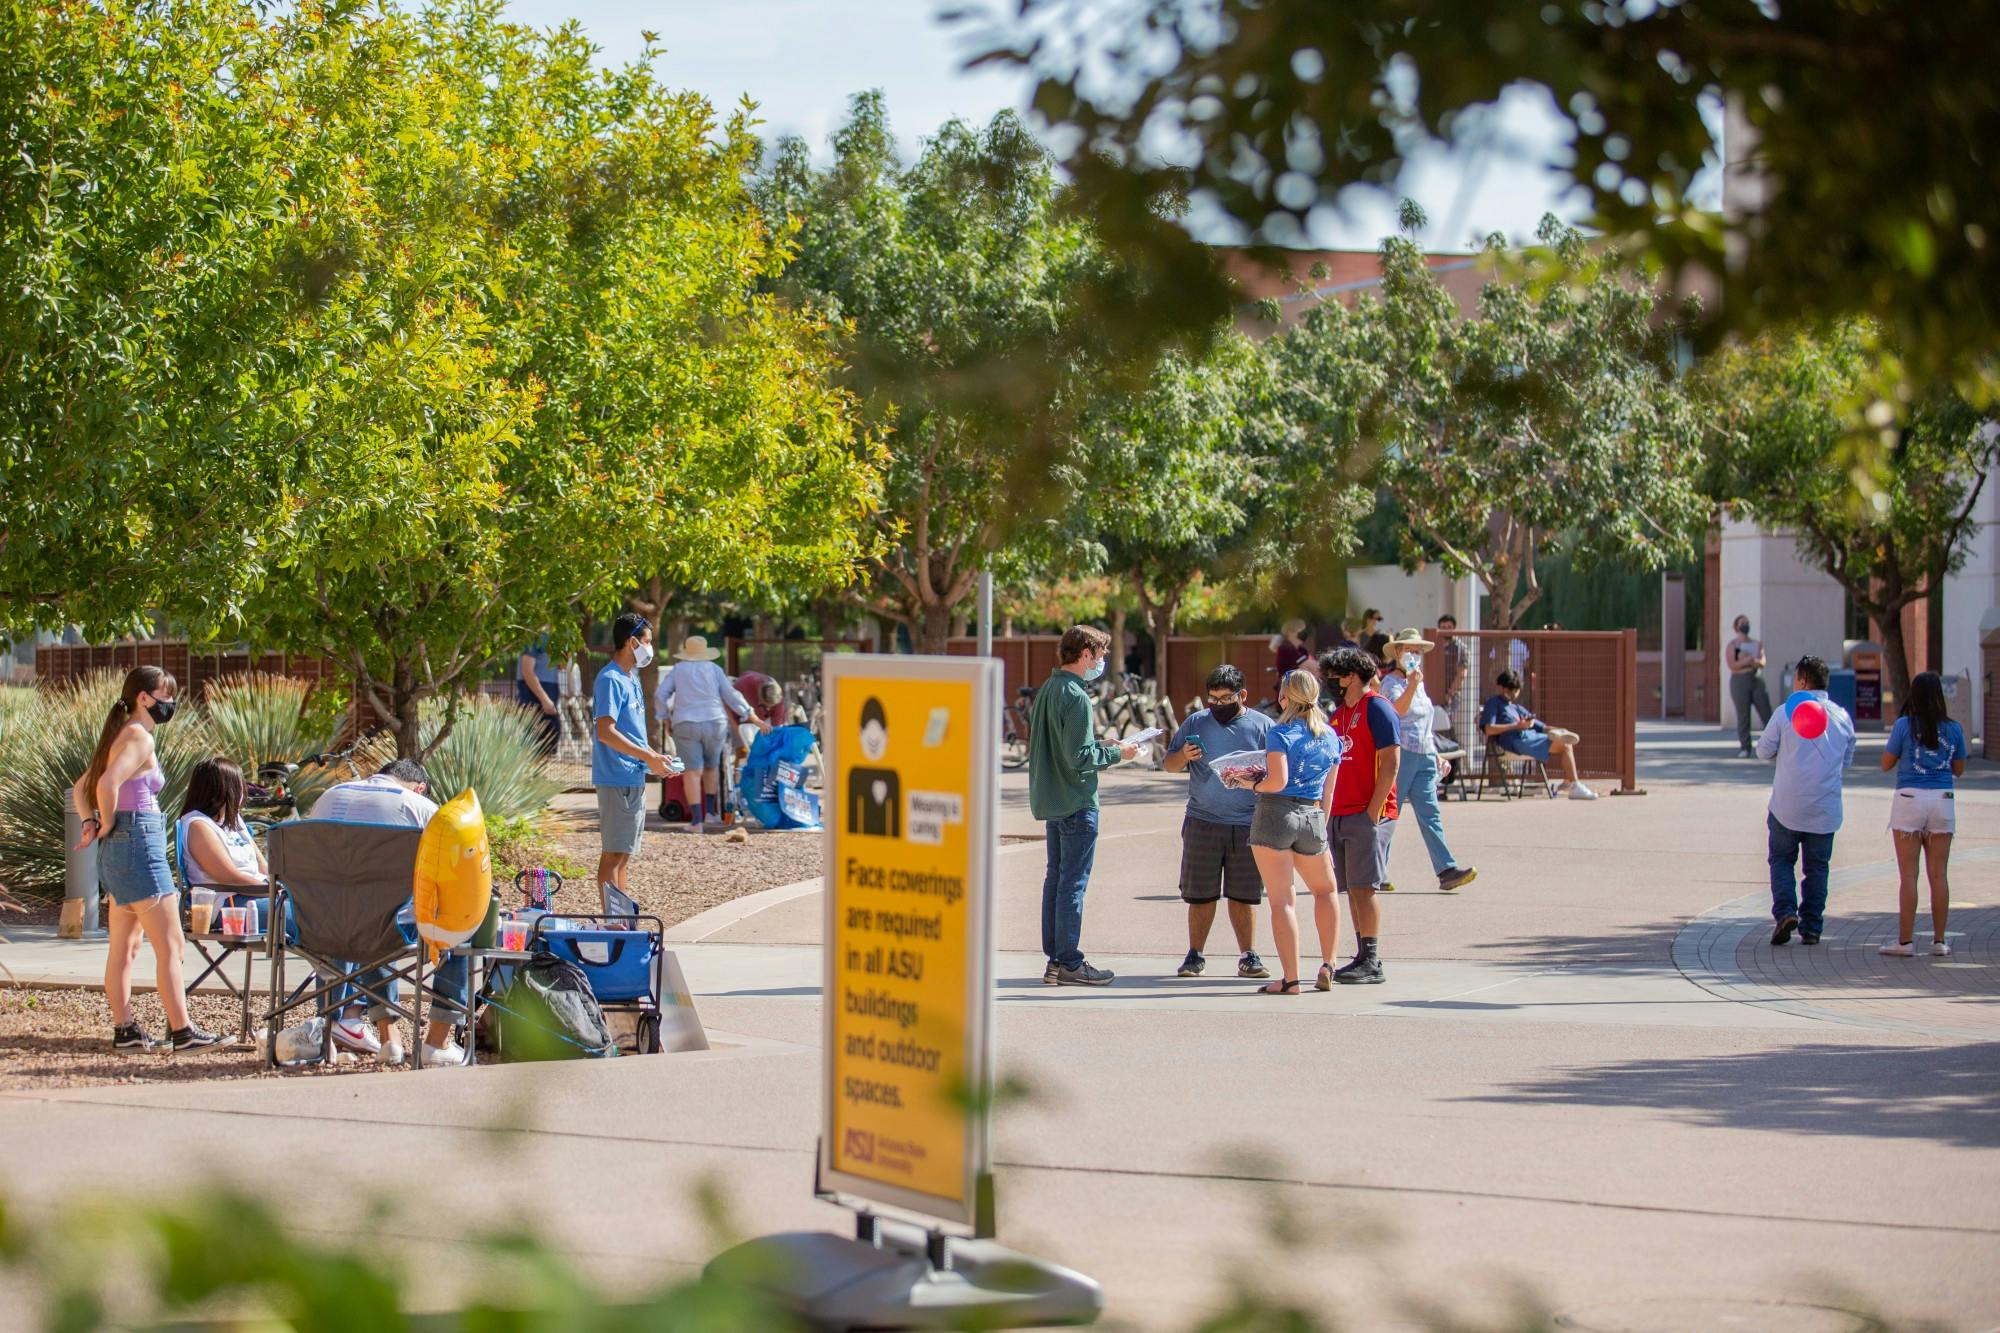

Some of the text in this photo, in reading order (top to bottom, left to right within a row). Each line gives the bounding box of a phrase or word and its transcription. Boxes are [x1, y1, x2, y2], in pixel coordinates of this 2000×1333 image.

[846, 857, 964, 905] Face coverings
[846, 907, 942, 941] are required
[846, 942, 925, 981] in all ASU
[845, 986, 918, 1029] buildings
[845, 1032, 942, 1074] and outdoor
[845, 1076, 904, 1109] spaces.
